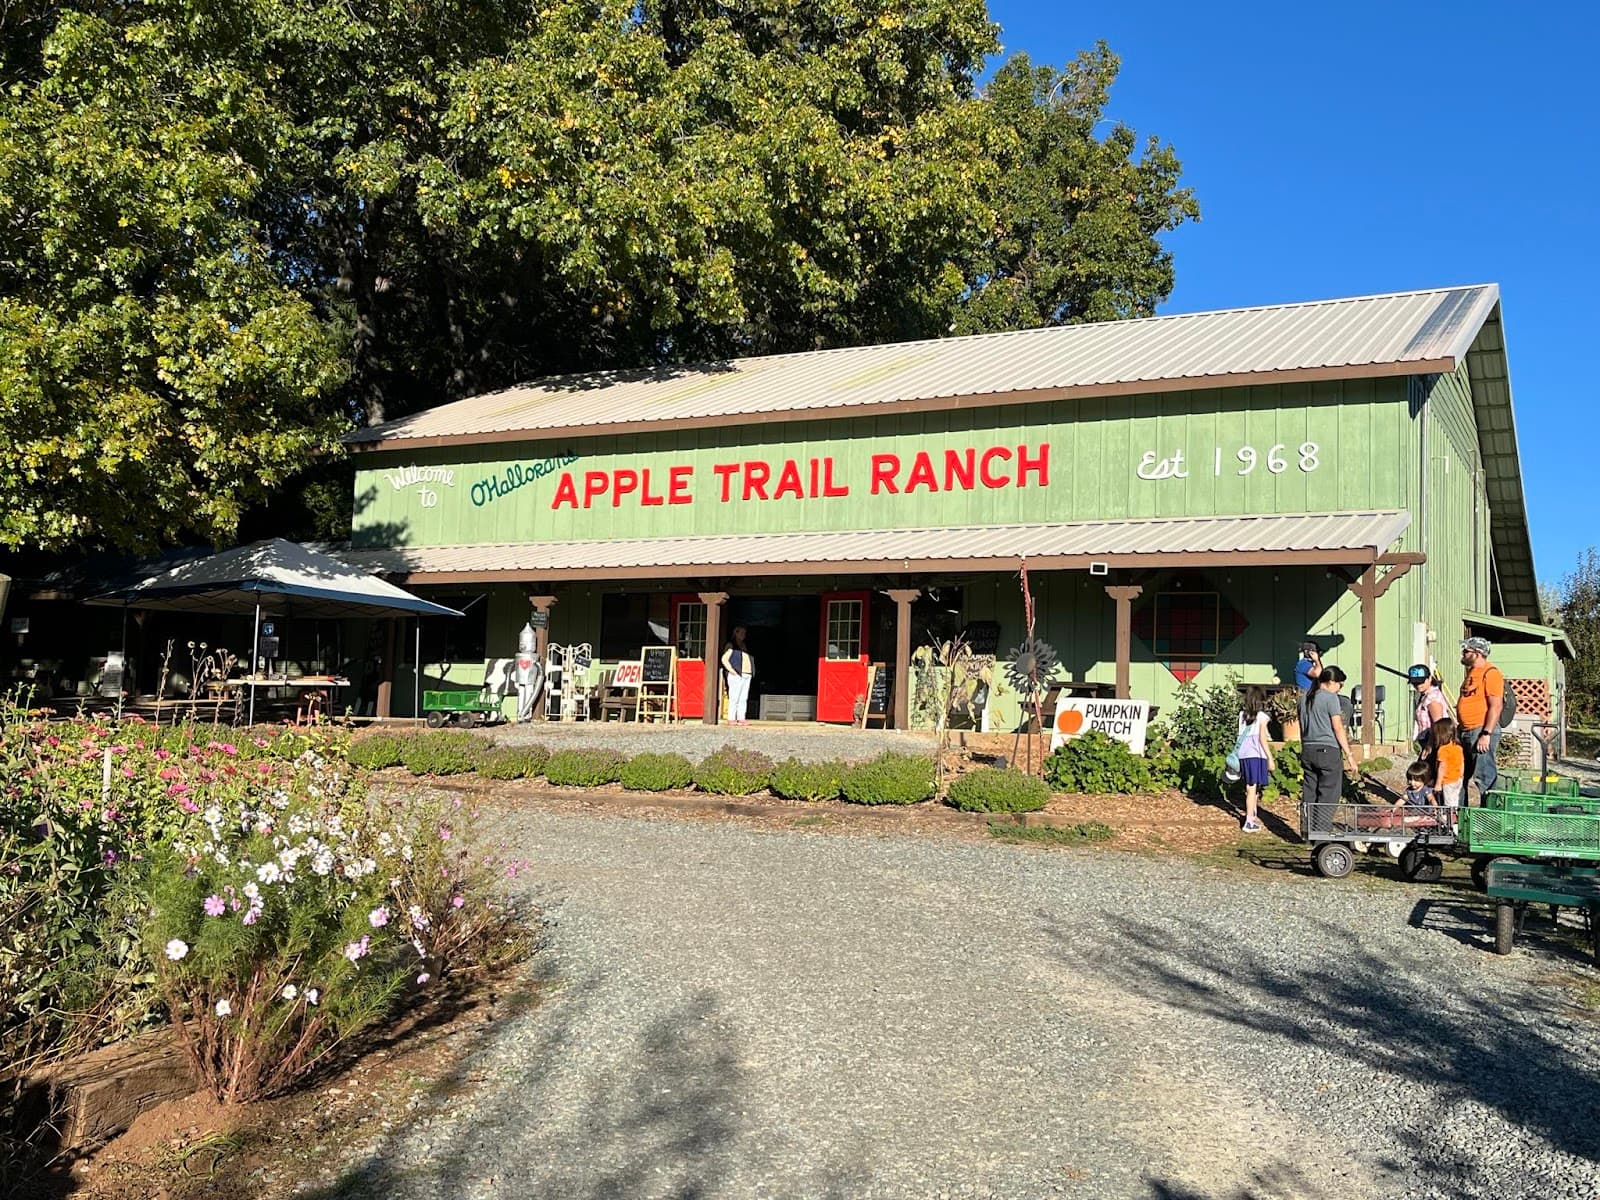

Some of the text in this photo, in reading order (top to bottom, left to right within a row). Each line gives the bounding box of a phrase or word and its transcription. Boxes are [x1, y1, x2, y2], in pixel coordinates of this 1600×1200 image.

[1136, 441, 1320, 480] Est 1968
[383, 463, 456, 491] Welcome
[551, 442, 1050, 510] APPLE TRAIL RANCH
[416, 485, 437, 508] to
[1085, 703, 1142, 720] PUMPKIN
[1090, 719, 1132, 735] PATCH
